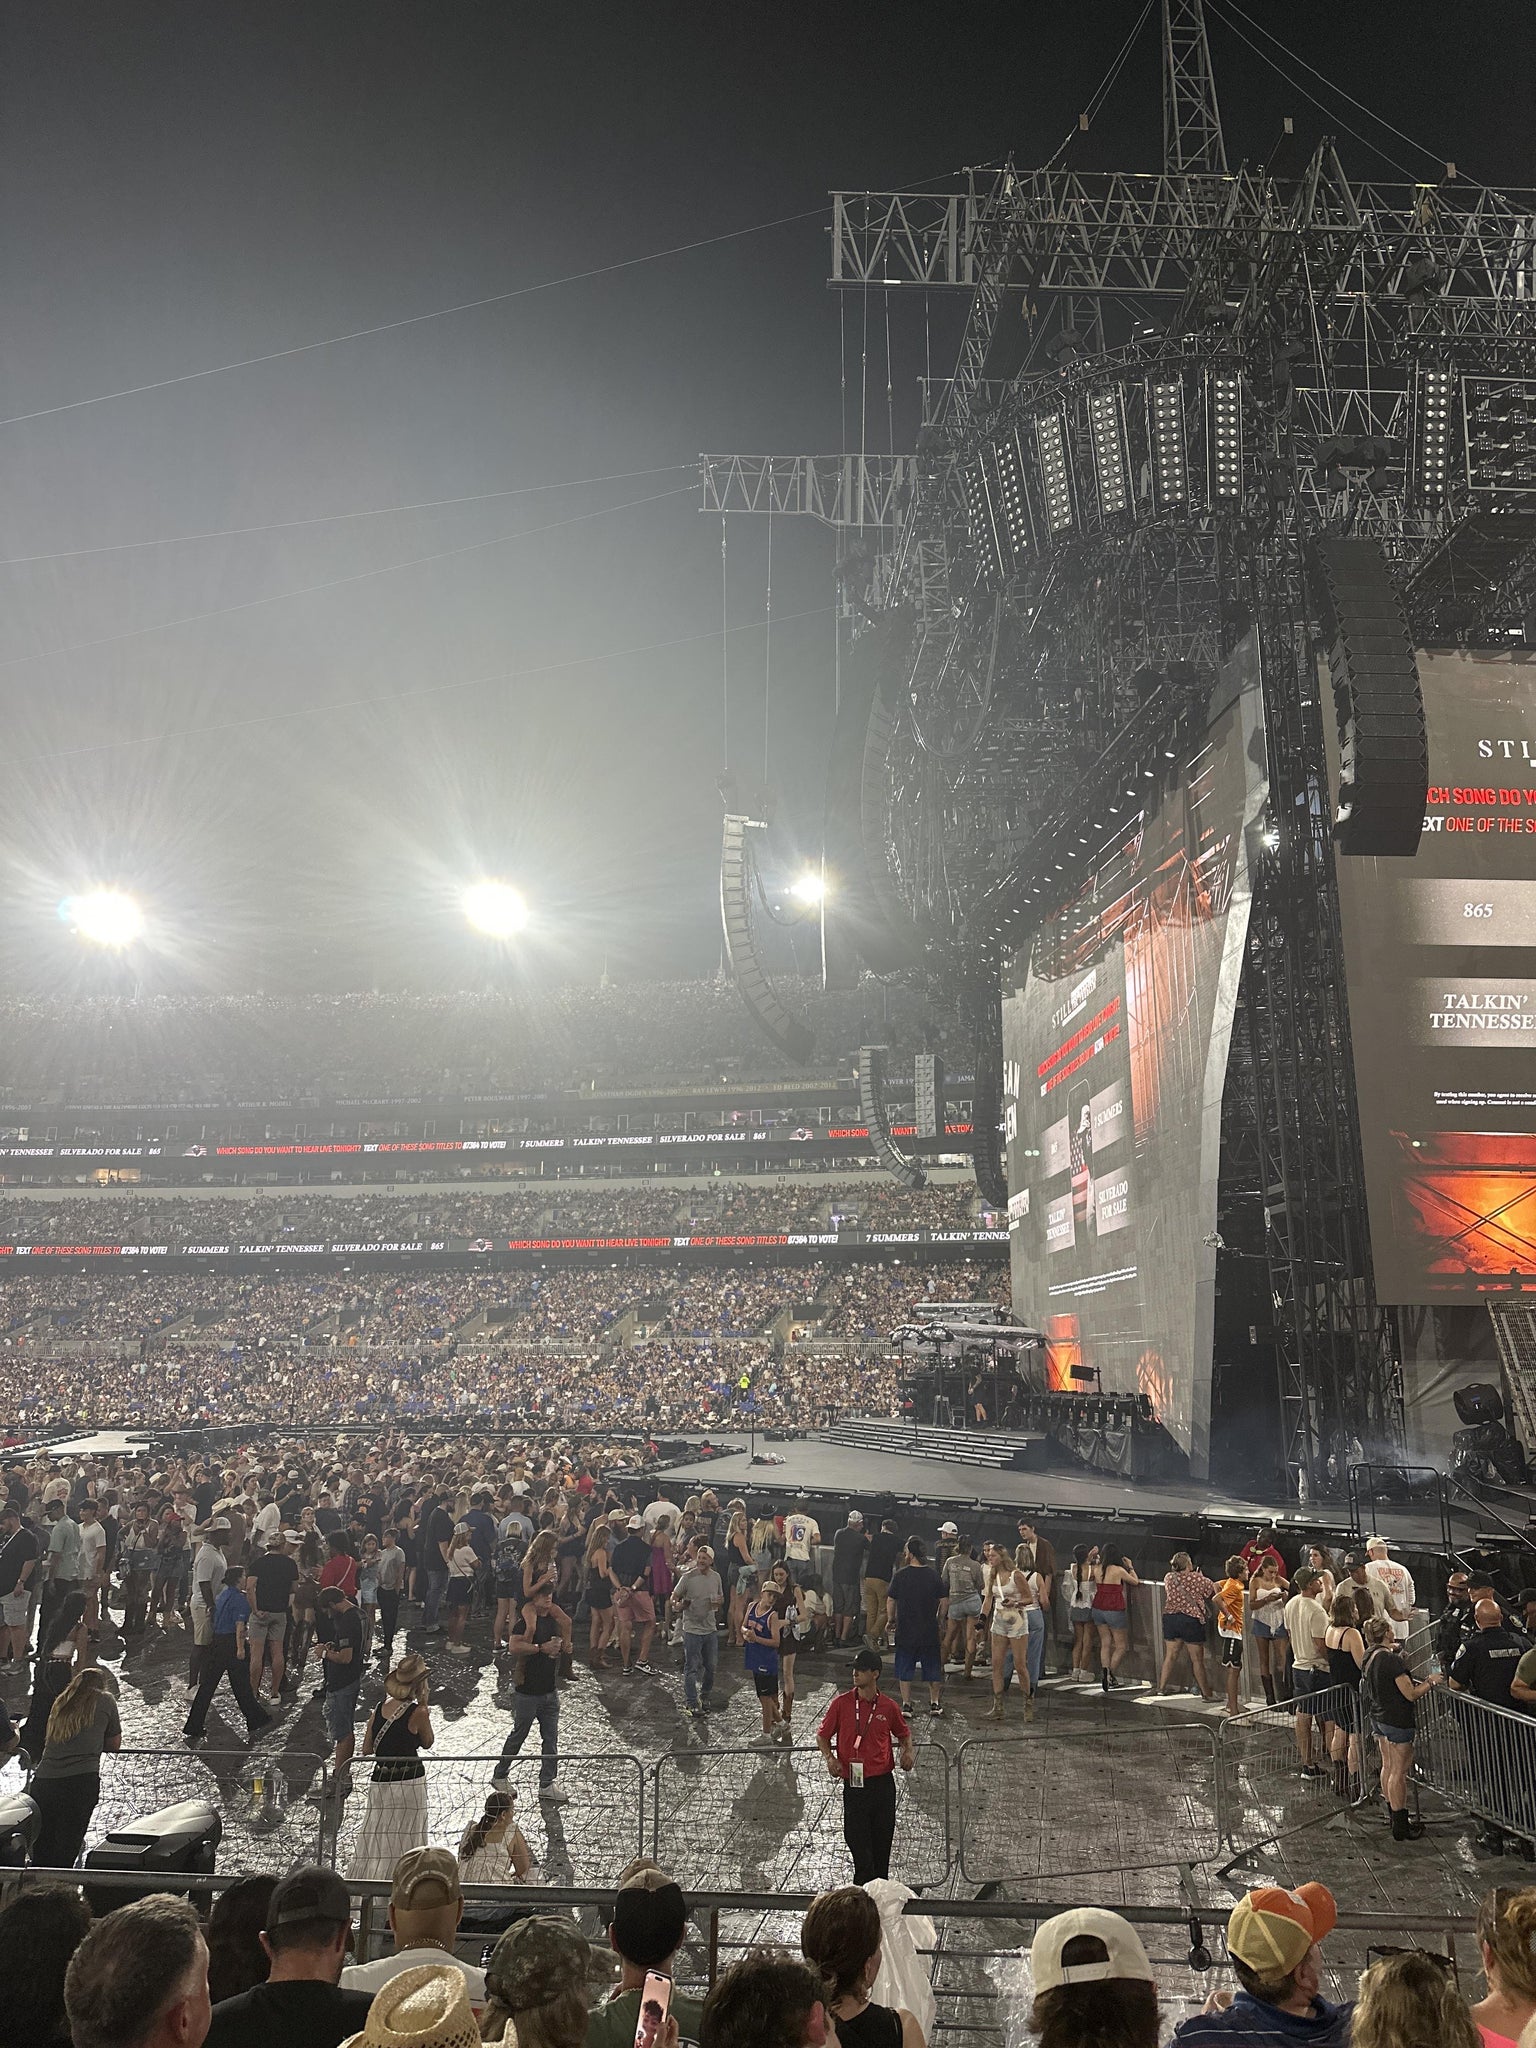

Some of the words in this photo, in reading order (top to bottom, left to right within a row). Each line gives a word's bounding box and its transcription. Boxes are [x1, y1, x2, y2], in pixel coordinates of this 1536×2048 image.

[1478, 739, 1536, 758] STI
[1427, 787, 1450, 803] CH
[1453, 787, 1497, 805] SONG
[1499, 788, 1521, 806] DO
[1421, 816, 1444, 832] EXT
[1446, 816, 1475, 832] ONE
[1477, 817, 1495, 833] OF
[1497, 818, 1523, 833] THE
[1463, 903, 1494, 918] 865
[957, 1074, 975, 1083] JAMA
[753, 1132, 766, 1140] 865
[828, 1129, 850, 1137] WHICH
[851, 1128, 869, 1137] SONG
[894, 1127, 913, 1136] WANT
[607, 1136, 652, 1145] TENNESSEE
[660, 1134, 705, 1143] SILVERADO
[706, 1134, 723, 1142] FOR
[725, 1133, 746, 1141] SALE
[216, 1147, 237, 1155] WHICH
[237, 1147, 254, 1155] SONG
[254, 1147, 263, 1155] DO
[264, 1146, 276, 1154] YOU
[277, 1146, 294, 1154] WANT
[295, 1145, 302, 1153] TO
[303, 1144, 319, 1153] HEAR
[319, 1144, 332, 1153] LIVE
[333, 1144, 361, 1152] TONIGHT?
[363, 1144, 379, 1152] TEXT
[379, 1143, 392, 1152] ONE
[392, 1143, 400, 1151] OF
[401, 1143, 418, 1151] THESE
[419, 1142, 435, 1151] SONG
[454, 1141, 462, 1149] TO
[481, 1141, 489, 1149] TO
[525, 1140, 564, 1148] SUMMERS
[10, 1148, 54, 1156] TENNESSEE
[60, 1148, 104, 1156] SILVERADO
[149, 1147, 161, 1155] 865
[1099, 1180, 1128, 1204] SILVERADO
[1101, 1204, 1112, 1220] FOR
[1113, 1198, 1127, 1215] SALE
[872, 1233, 919, 1242] SUMMERS
[973, 1231, 1010, 1240] TENNES
[430, 1242, 444, 1250] 865
[508, 1240, 531, 1249] WHICH
[532, 1240, 550, 1249] SONG
[551, 1240, 560, 1248] DO
[561, 1240, 575, 1248] YOU
[575, 1239, 595, 1248] WANT
[596, 1239, 604, 1247] TO
[606, 1238, 625, 1247] HEAR
[625, 1238, 638, 1247] LIVE
[639, 1237, 671, 1247] TONIGHT?
[673, 1237, 690, 1246] TEXT
[690, 1237, 705, 1246] ONE
[705, 1237, 715, 1245] OF
[715, 1236, 736, 1245] THESE
[736, 1236, 755, 1245] SONG
[756, 1235, 778, 1245] TITLES
[778, 1235, 787, 1244] TO
[808, 1234, 818, 1243] TO
[818, 1234, 839, 1243] VOTE!
[16, 1246, 32, 1255] TEXT
[31, 1246, 45, 1254] ONE
[46, 1246, 55, 1254] OF
[55, 1246, 74, 1254] THESE
[74, 1246, 92, 1254] SONG
[92, 1246, 112, 1254] TITLES
[112, 1246, 120, 1254] TO
[139, 1246, 149, 1254] TO
[187, 1246, 229, 1254] SUMMERS
[276, 1245, 324, 1253] TENNESSEE
[331, 1244, 380, 1252] SILVERADO
[381, 1243, 399, 1251] FOR
[400, 1243, 422, 1251] SALE
